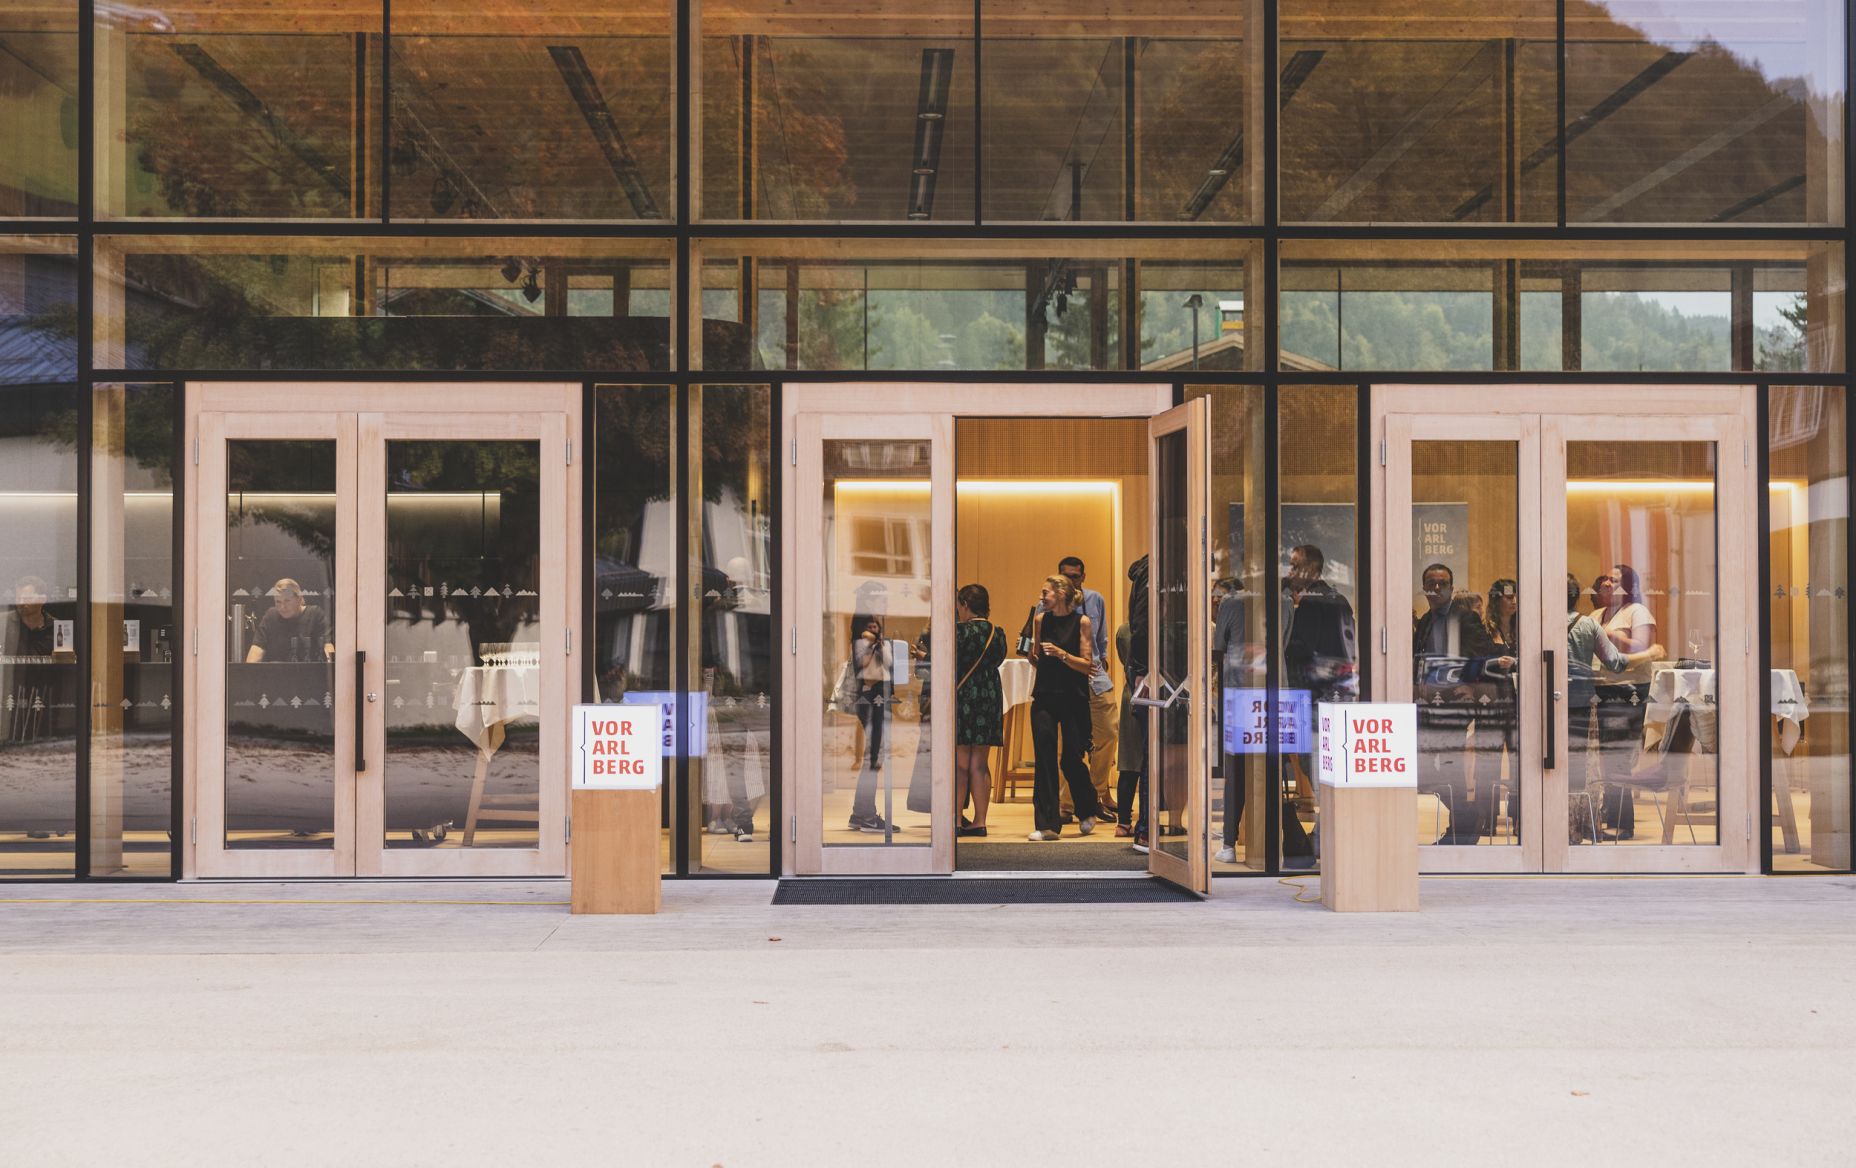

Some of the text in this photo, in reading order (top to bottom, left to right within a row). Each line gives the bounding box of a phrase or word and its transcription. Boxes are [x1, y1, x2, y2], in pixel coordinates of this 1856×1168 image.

[1424, 523, 1447, 533] VOR
[1424, 534, 1446, 543] ARL
[1425, 545, 1454, 554] BERG
[592, 720, 632, 736] VOR
[1352, 719, 1393, 734] VOR
[592, 740, 630, 755] ARL
[1353, 738, 1391, 753] ARL
[593, 759, 644, 775] BERG
[1355, 757, 1406, 773] BERG
